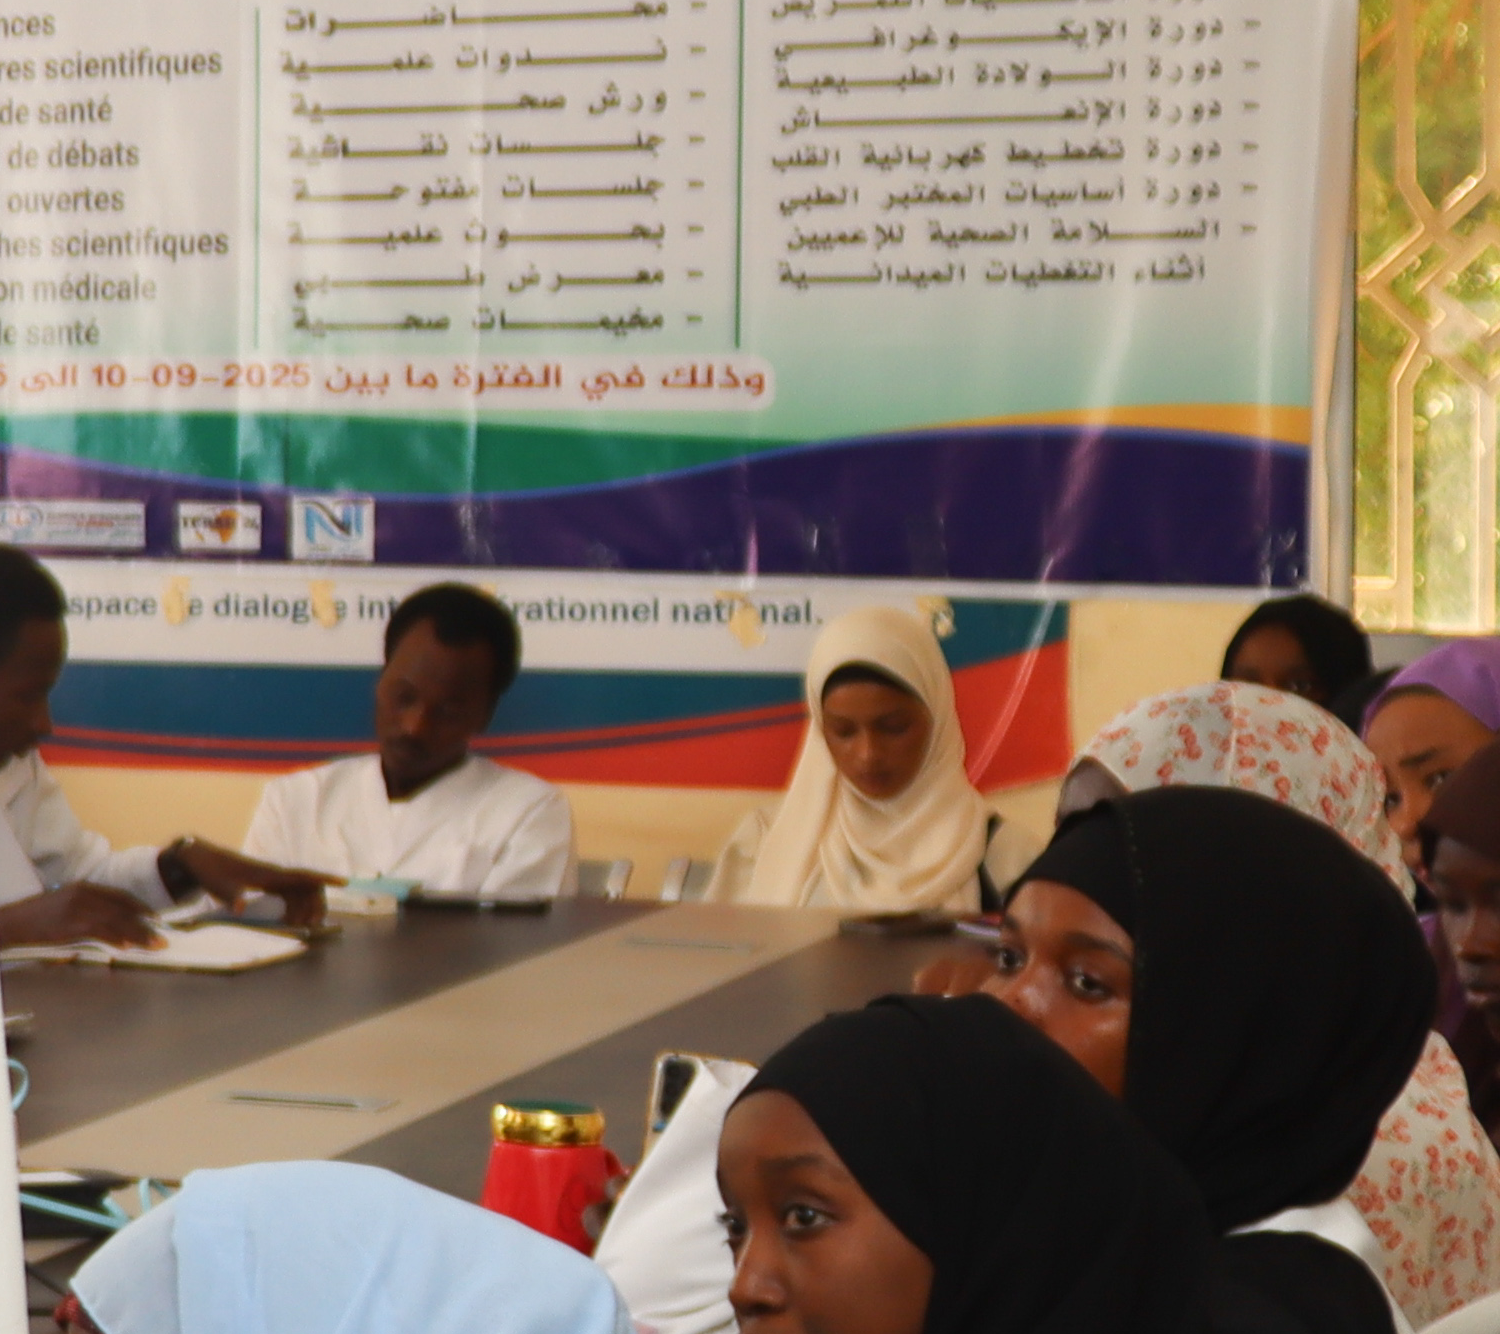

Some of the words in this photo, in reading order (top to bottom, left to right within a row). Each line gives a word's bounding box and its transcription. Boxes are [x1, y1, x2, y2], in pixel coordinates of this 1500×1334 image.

[44, 45, 223, 85] scientifiques
[37, 92, 114, 126] santé
[7, 139, 40, 170] de
[47, 137, 141, 169] débats
[6, 186, 126, 214] ouvertes
[50, 226, 230, 264] scientifiques
[31, 273, 157, 303] médicale
[24, 317, 102, 348] santé
[325, 366, 391, 397] بين
[405, 361, 440, 390] ما
[452, 361, 563, 396] الفترة
[580, 363, 646, 402] في
[661, 361, 767, 397] وذلك
[67, 591, 157, 620] space
[213, 587, 347, 624] dialoge
[520, 597, 660, 624] rationnel
[671, 597, 823, 627] natinal.
